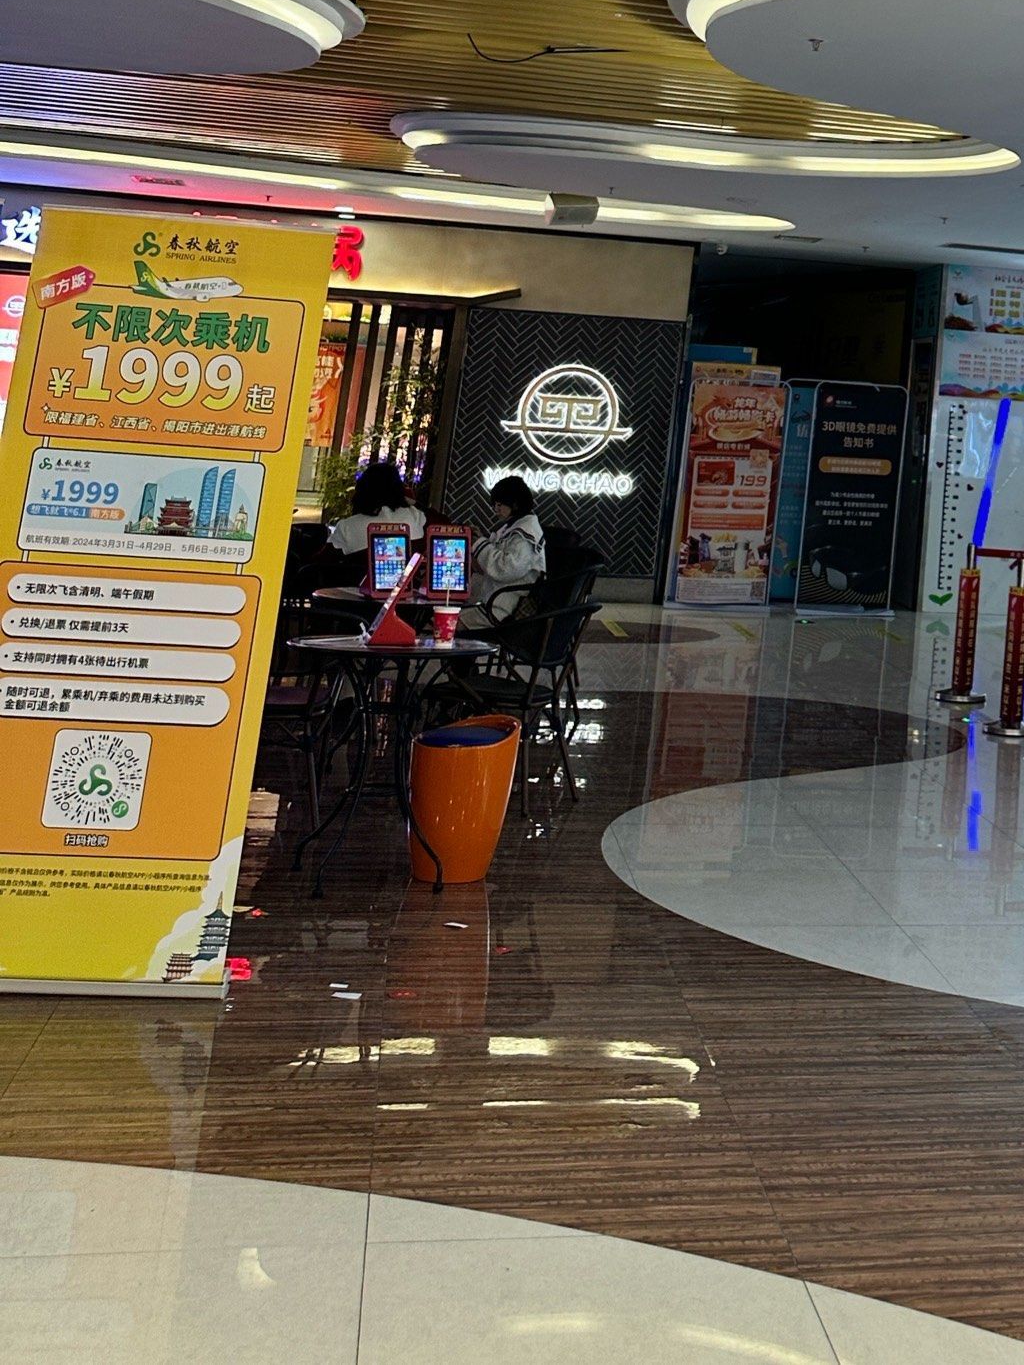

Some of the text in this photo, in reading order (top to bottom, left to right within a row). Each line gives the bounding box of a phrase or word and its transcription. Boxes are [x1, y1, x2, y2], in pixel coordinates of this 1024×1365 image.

[166, 233, 240, 256] 春秋航空
[165, 252, 237, 265] SPRING AIRLINES
[38, 269, 90, 300] 南方版
[71, 302, 272, 354] 不限次乘机
[43, 411, 267, 440] 限福建省、江西省、揭阳市进出港航线
[54, 458, 92, 470] 春秋航空
[40, 479, 120, 505] ¥1999
[562, 470, 635, 496] CHAO
[24, 582, 155, 602] 无限次飞含清明、端午假期
[12, 650, 150, 670] 支持同时拥有4张待出行机票
[3, 699, 71, 714] 金额可退余额
[63, 833, 110, 848] 扫码抢购
